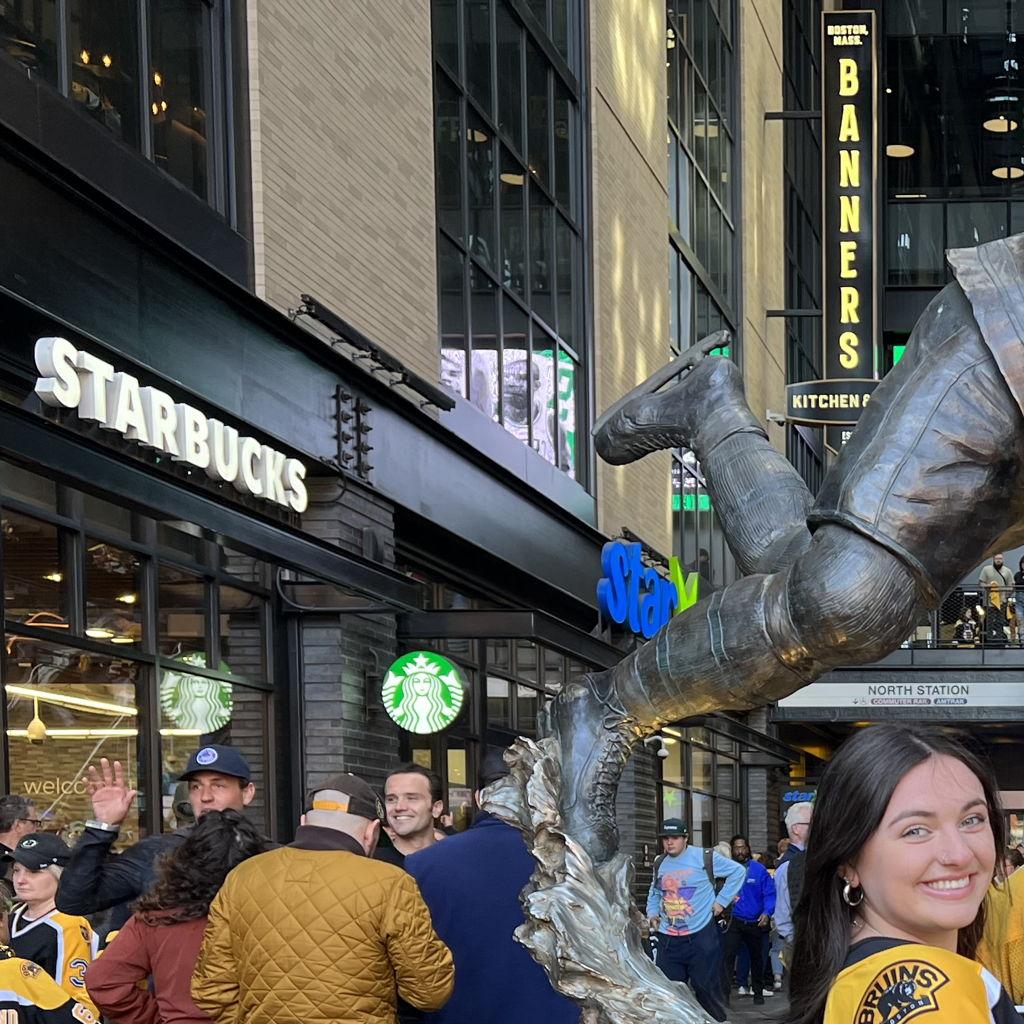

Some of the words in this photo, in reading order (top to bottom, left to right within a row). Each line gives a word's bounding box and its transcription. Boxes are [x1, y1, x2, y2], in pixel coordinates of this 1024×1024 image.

[827, 25, 869, 36] BOSTON,
[833, 36, 862, 46] MASS.
[838, 58, 860, 370] BANNERS
[792, 394, 860, 409] KITCHEN
[34, 337, 308, 513] STARBUCKS
[597, 532, 678, 640] Star
[868, 685, 913, 696] NORTH
[917, 685, 970, 696] STATION
[23, 777, 87, 795] welco
